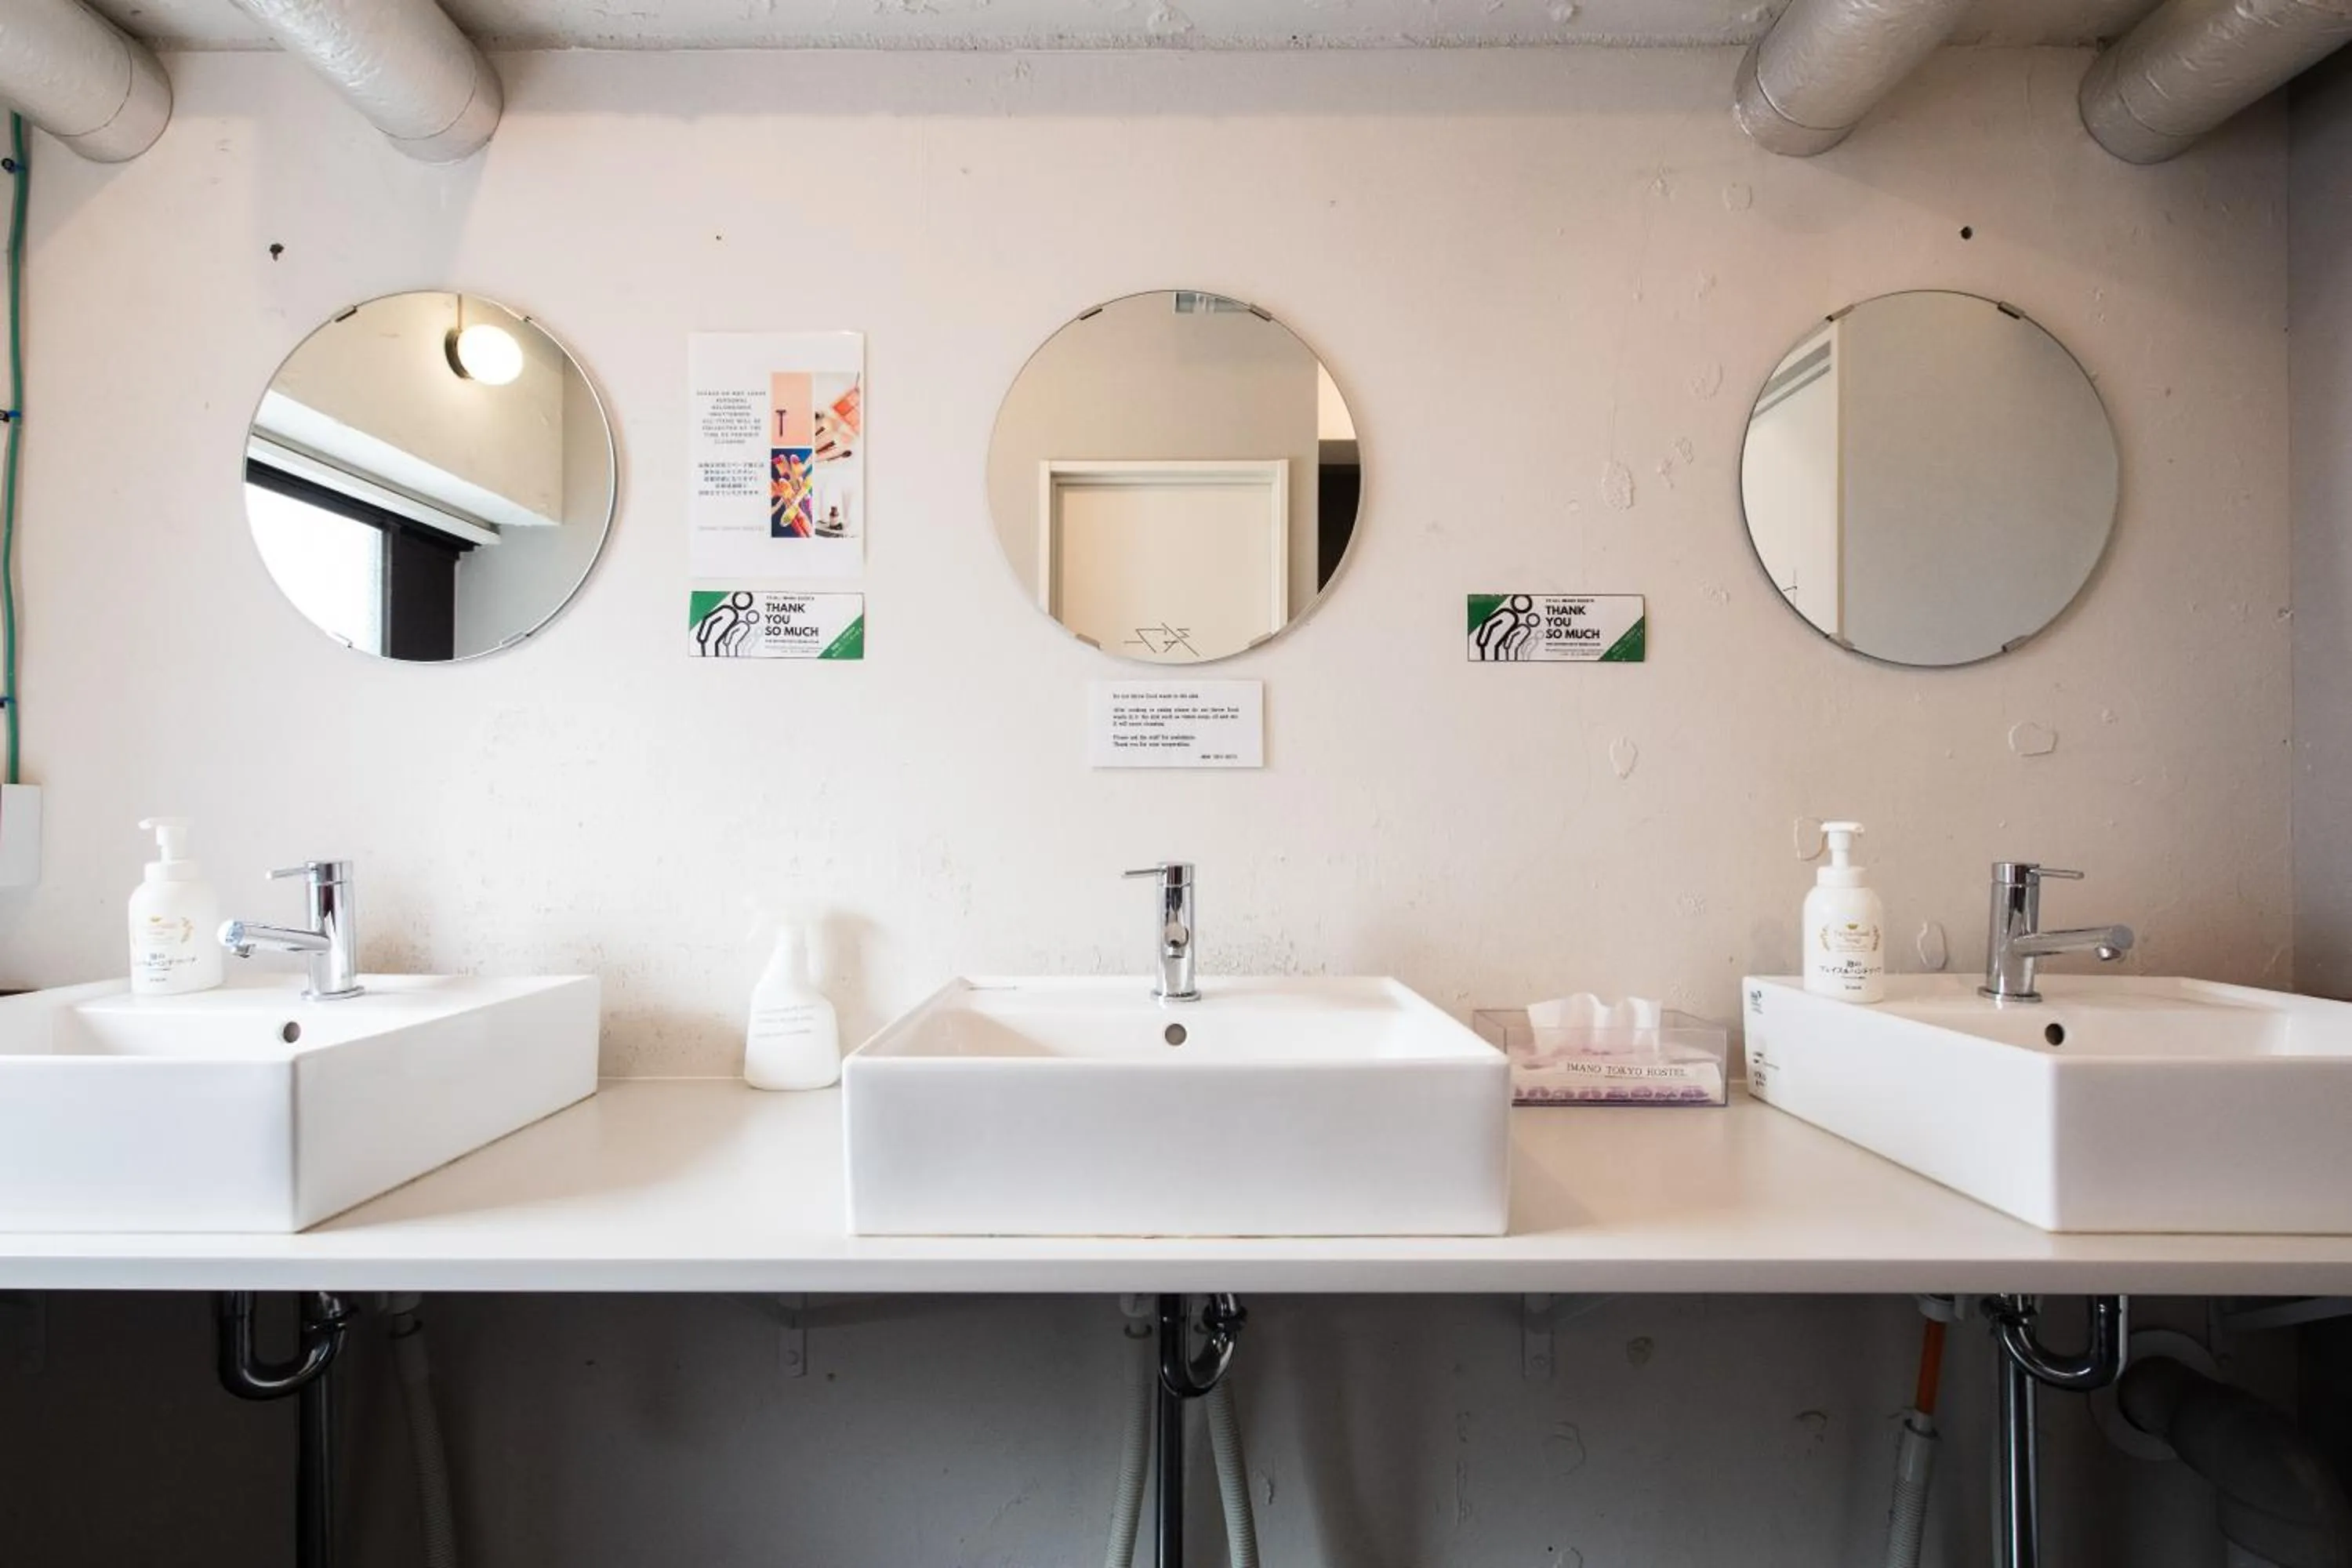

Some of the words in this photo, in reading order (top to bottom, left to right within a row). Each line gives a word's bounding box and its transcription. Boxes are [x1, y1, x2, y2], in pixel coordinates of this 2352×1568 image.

[765, 603, 805, 613] THANK
[1545, 605, 1586, 615] THANK
[765, 614, 790, 624] YOU
[1545, 617, 1571, 626] YOU
[765, 626, 781, 636] SO
[784, 627, 818, 637] MUCH
[1545, 629, 1563, 638] SO
[1565, 629, 1600, 638] MUCH
[1567, 1062, 1602, 1073] IMANO
[1606, 1065, 1642, 1076] TOKYO
[1647, 1066, 1686, 1077] HOSTEL
